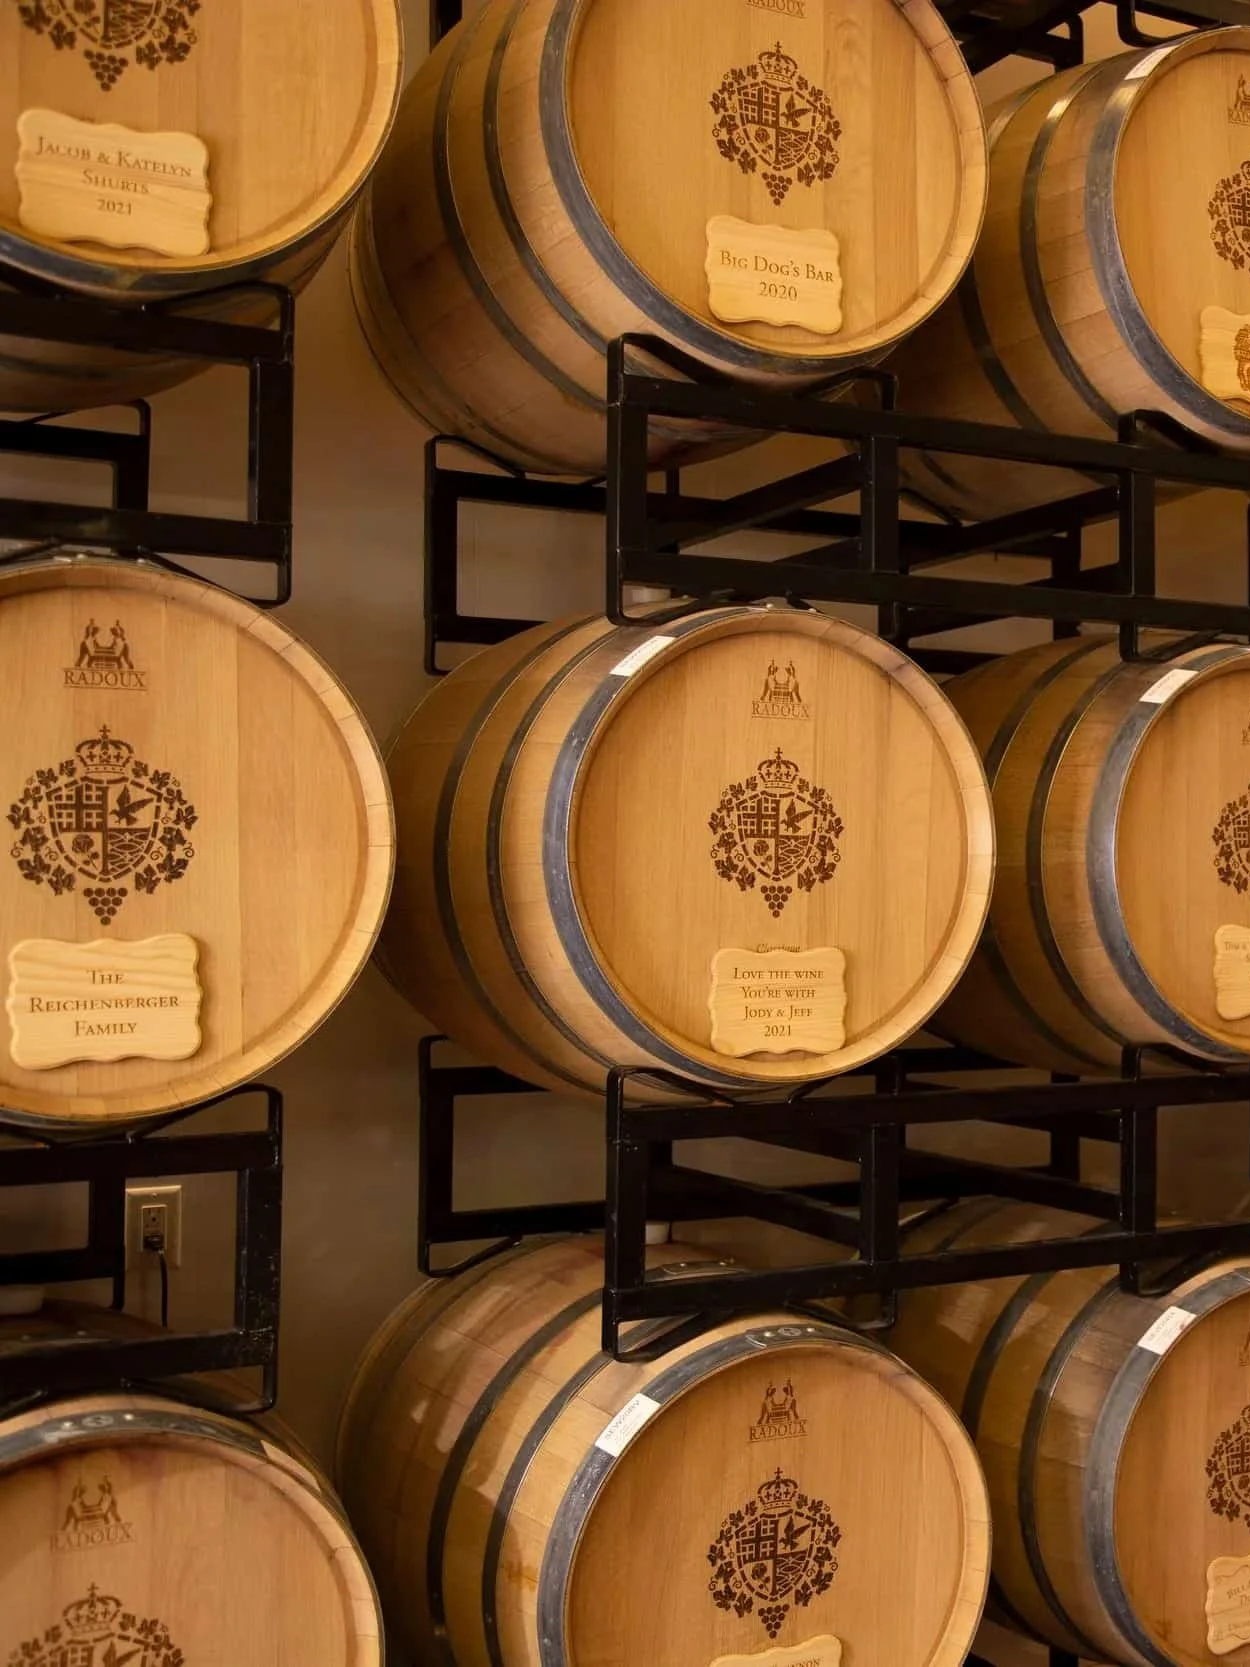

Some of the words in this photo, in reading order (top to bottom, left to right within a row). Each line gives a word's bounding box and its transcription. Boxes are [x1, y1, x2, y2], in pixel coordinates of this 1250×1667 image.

[747, 0, 805, 16] DOUX
[36, 136, 91, 160] JACOB
[97, 152, 111, 165] &
[117, 150, 192, 177] KATELYN
[82, 168, 150, 194] SHURTS
[97, 198, 133, 215] 2021
[720, 249, 748, 270] BIG
[753, 255, 800, 278] DOG'S
[805, 263, 834, 282] BAR
[759, 281, 798, 301] 2020
[64, 671, 146, 687] RADOUX
[751, 700, 810, 718] RADOUX
[86, 969, 125, 985] THE
[733, 967, 765, 980] LOVE
[767, 970, 790, 980] THE
[793, 970, 824, 980] WINE
[741, 986, 781, 999] YOU'RE
[785, 989, 816, 998] WITH
[29, 996, 180, 1013] REICHENBERGER
[744, 1006, 774, 1020] JODY
[776, 1008, 785, 1017] &
[788, 1005, 814, 1020] JEFF
[74, 1020, 137, 1037] FAMILY
[763, 1025, 792, 1037] 2021
[749, 1419, 808, 1441] RADOUX
